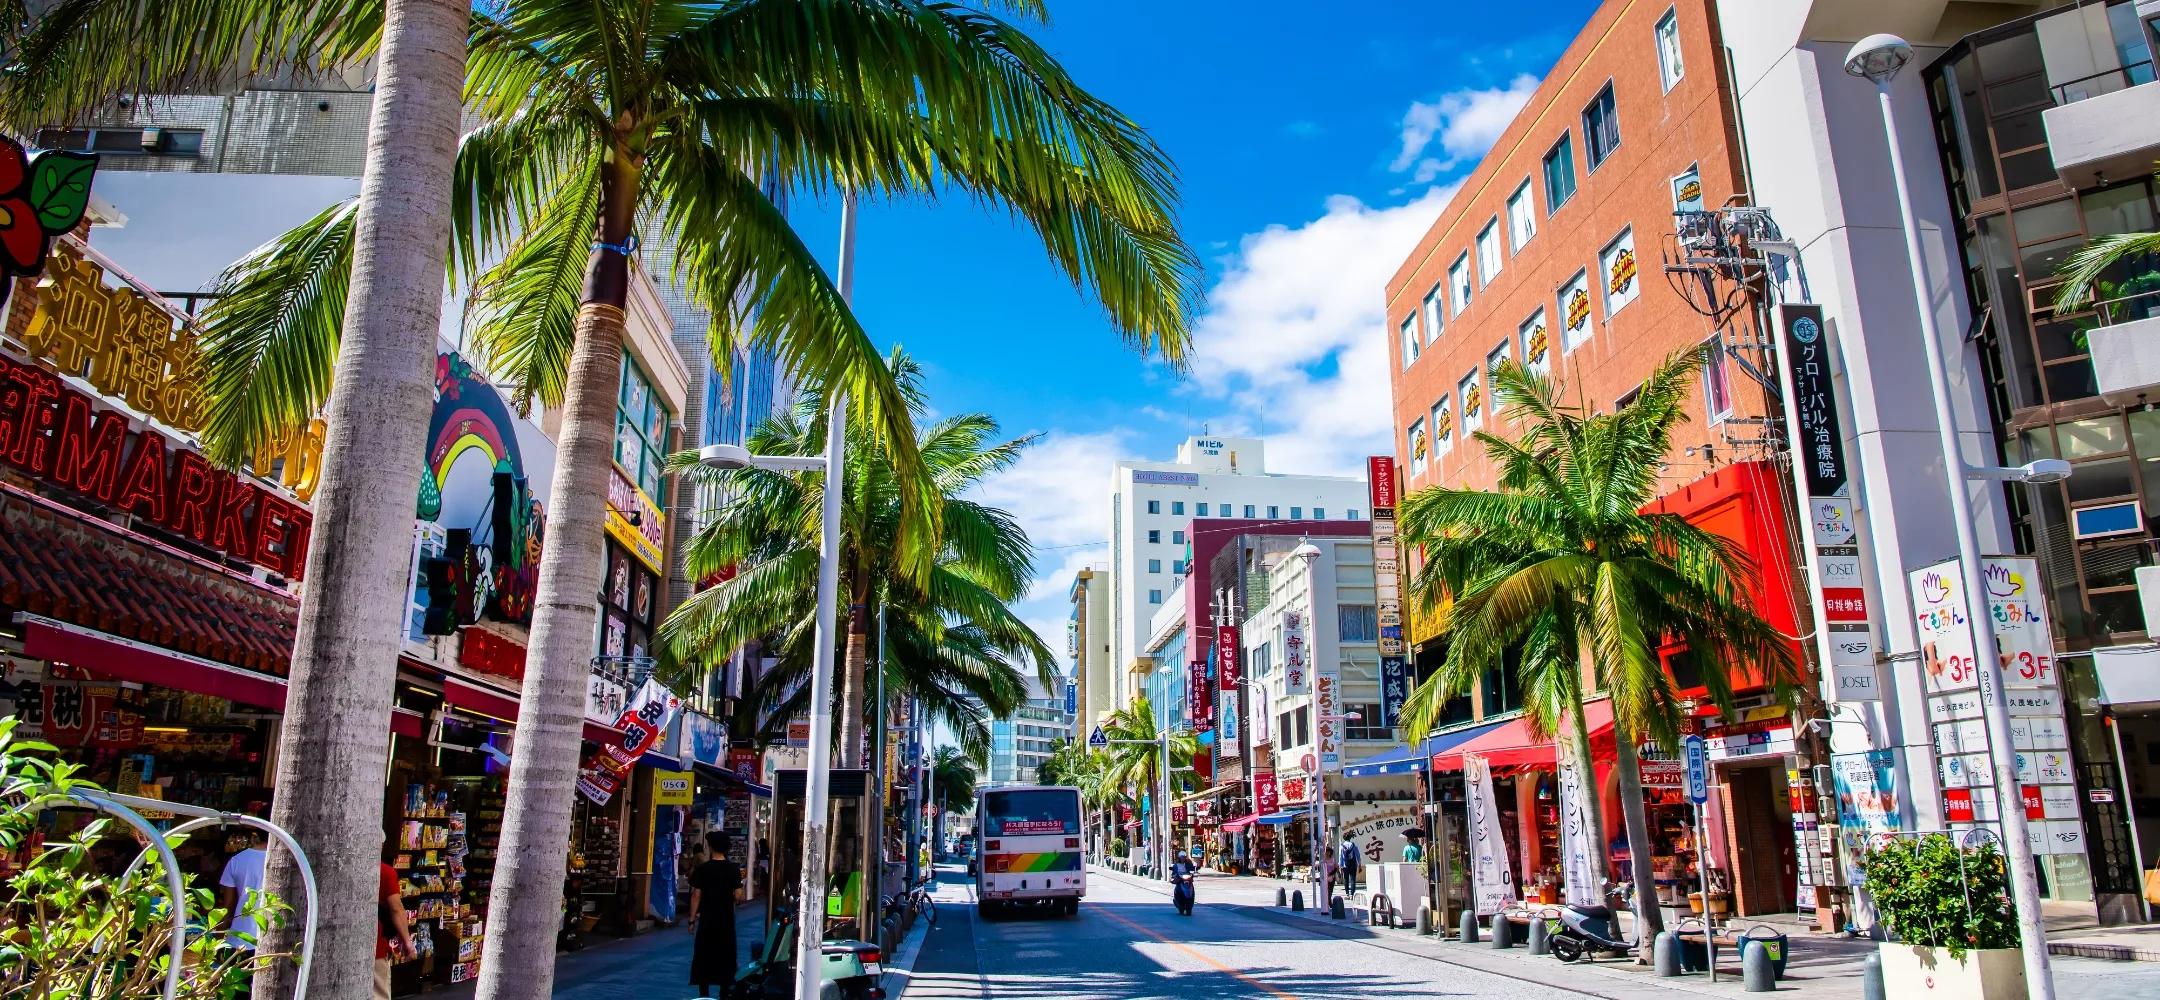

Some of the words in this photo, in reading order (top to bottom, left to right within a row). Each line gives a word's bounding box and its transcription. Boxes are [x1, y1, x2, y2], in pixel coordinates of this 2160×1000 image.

[1803, 345, 1836, 478] グローバル治療院
[48, 392, 313, 582] MARKET
[1817, 522, 1850, 532] てもみん
[1825, 563, 1854, 576] JOSET
[1919, 607, 1964, 630] てもみん
[1990, 604, 2040, 623] もみん
[1950, 655, 1974, 683] 3F
[2018, 652, 2051, 680] 3F
[1841, 677, 1871, 689] JOSET
[15, 681, 83, 730] 免税
[1642, 773, 1682, 783] キッドハ
[1690, 747, 1703, 792] 国際通り
[2042, 769, 2067, 777] てもみん
[663, 781, 686, 789] りらくる
[1364, 835, 1385, 863] 守
